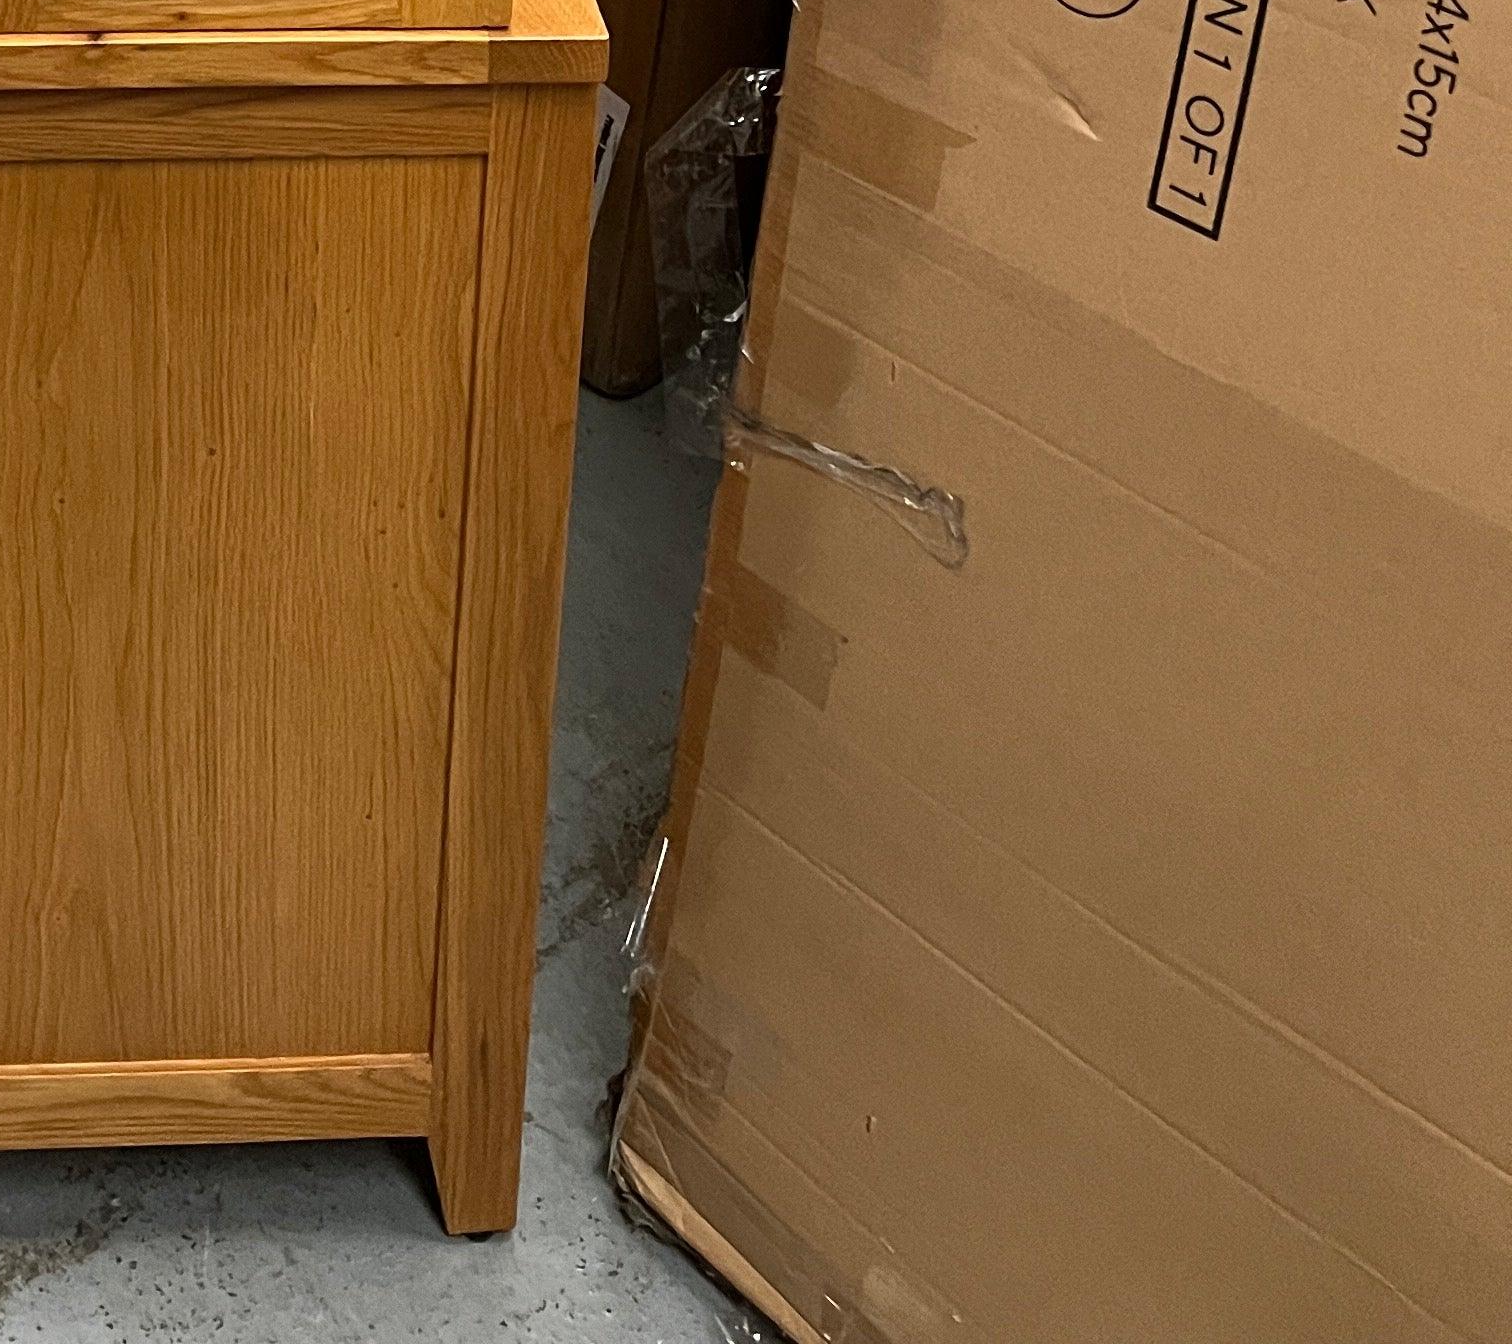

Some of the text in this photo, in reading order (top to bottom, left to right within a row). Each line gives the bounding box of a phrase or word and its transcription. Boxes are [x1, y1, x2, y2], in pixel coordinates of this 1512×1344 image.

[1193, 49, 1232, 72] 1
[1179, 95, 1225, 176] OF
[1168, 184, 1208, 208] 1
